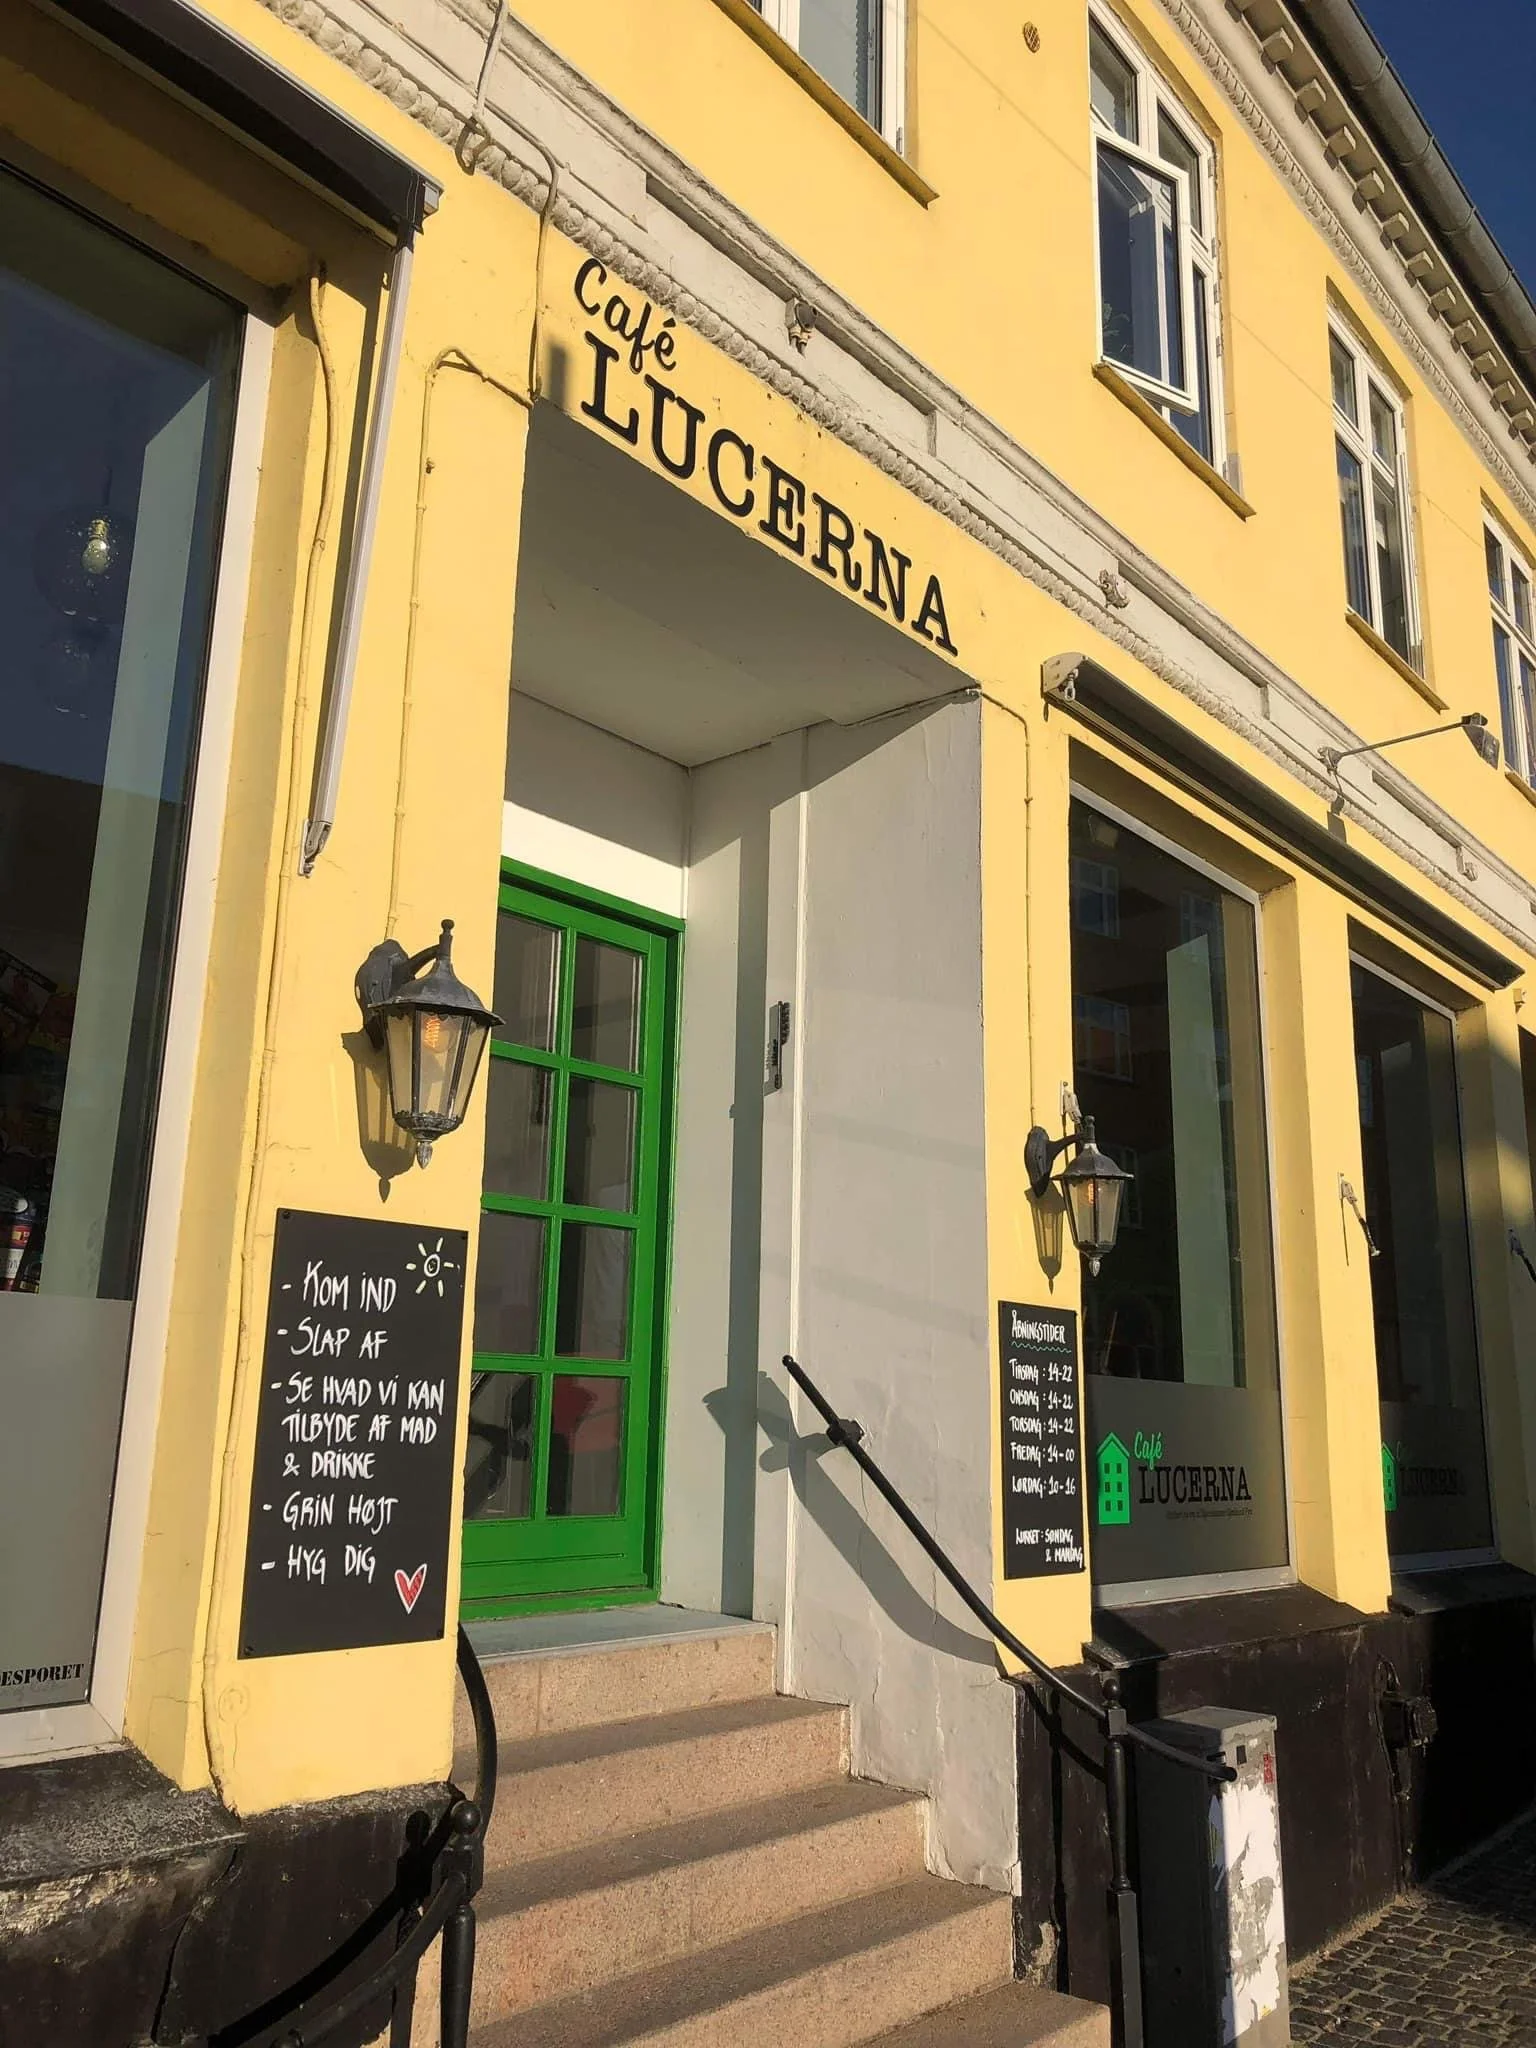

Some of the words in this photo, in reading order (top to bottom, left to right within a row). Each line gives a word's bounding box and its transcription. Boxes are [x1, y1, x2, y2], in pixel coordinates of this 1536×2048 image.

[573, 257, 678, 374] Café
[580, 330, 958, 657] LUCERNA
[303, 1260, 349, 1311] KOM
[290, 1316, 350, 1358] SLAP
[358, 1330, 388, 1359] AF
[1048, 1361, 1073, 1382] 14-22
[285, 1371, 313, 1404] SE
[322, 1375, 371, 1407] HVAD
[408, 1378, 445, 1416] KAN
[368, 1413, 392, 1443] AF
[400, 1415, 437, 1445] MAD
[1048, 1417, 1075, 1435] 14-22
[282, 1452, 300, 1477] &
[1133, 1431, 1163, 1471] Café
[1137, 1465, 1252, 1504] LUCERNA
[348, 1493, 399, 1535] HØJT
[287, 1544, 326, 1585] HYG
[0, 1663, 84, 1686] ESPORET
